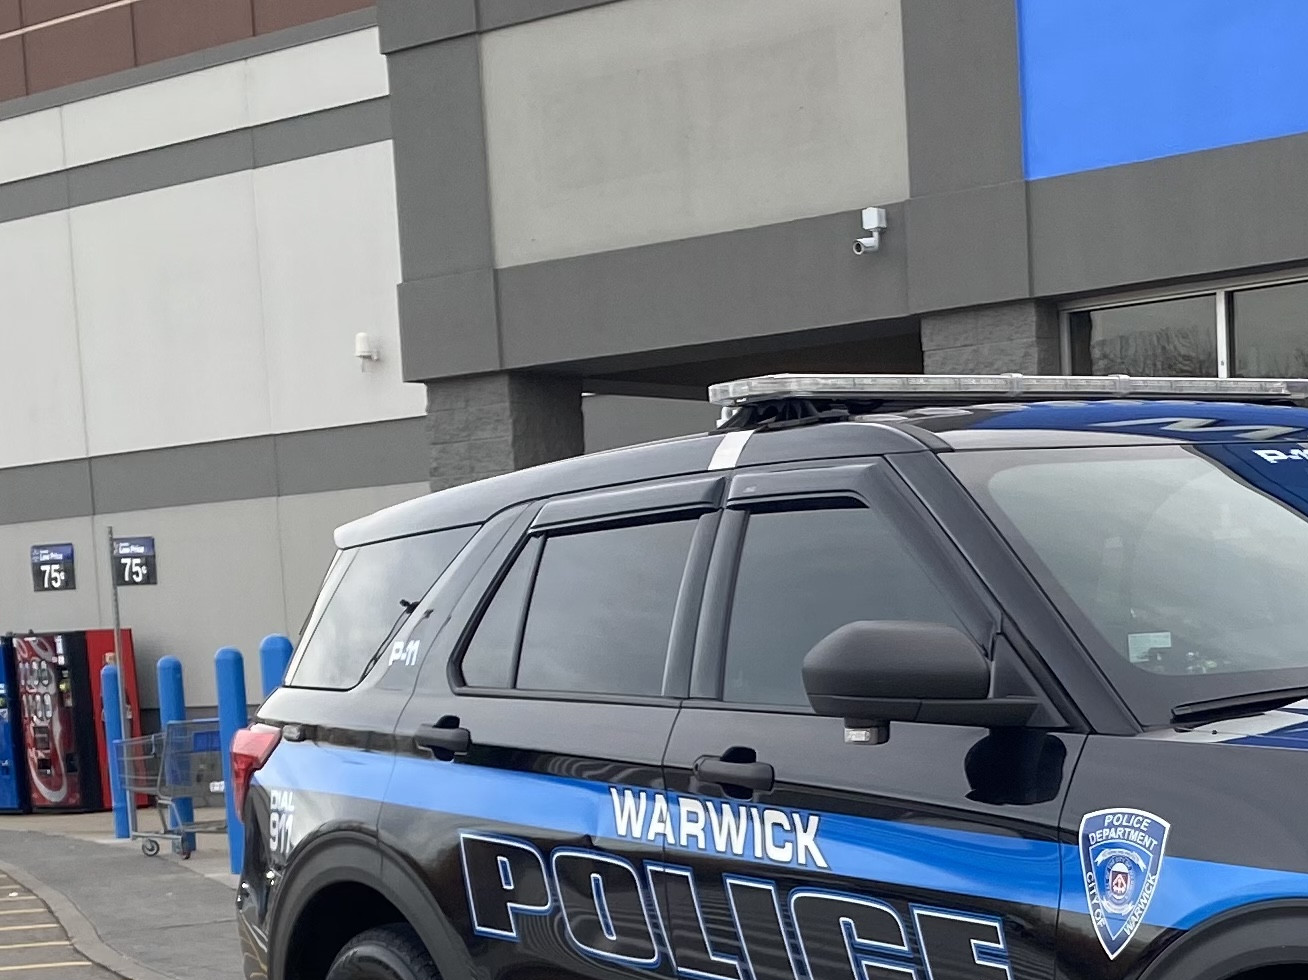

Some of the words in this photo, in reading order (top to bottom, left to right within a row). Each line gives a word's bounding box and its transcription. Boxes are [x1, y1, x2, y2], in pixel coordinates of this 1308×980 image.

[388, 640, 420, 666] P-11
[270, 789, 294, 812] DIAL
[269, 811, 294, 854] 911
[609, 787, 829, 869] WARWICK
[1104, 813, 1152, 832] POLICE
[1088, 827, 1158, 851] DEPARTMENT
[1086, 871, 1102, 904] CITY
[1094, 908, 1107, 928] OF
[1123, 873, 1157, 936] WARWICK
